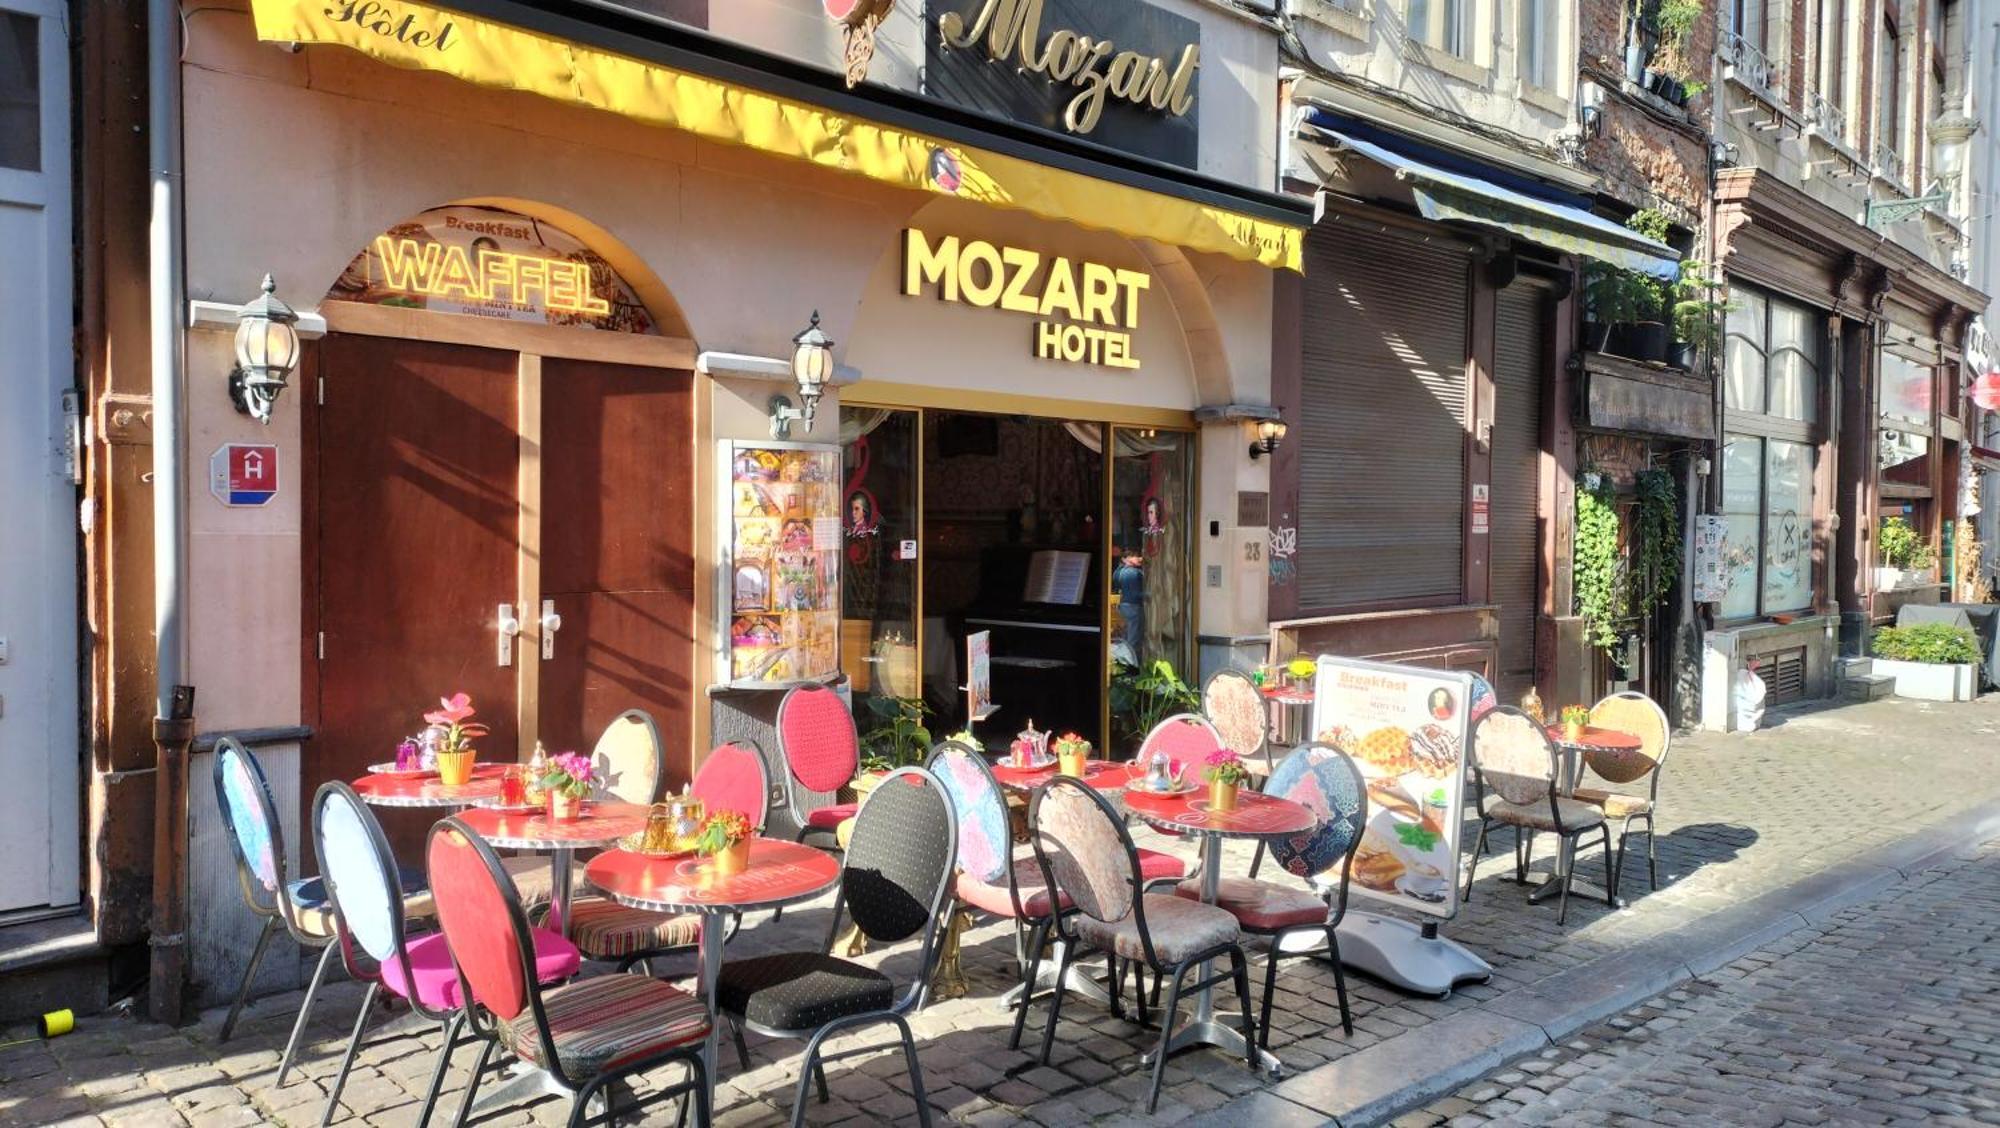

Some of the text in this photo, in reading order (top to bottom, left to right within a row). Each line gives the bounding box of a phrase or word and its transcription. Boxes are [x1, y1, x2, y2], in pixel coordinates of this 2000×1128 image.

[323, 0, 459, 52] Hôtel
[939, 0, 1200, 134] Mozart
[445, 215, 531, 241] Breakfast
[376, 235, 610, 315] WAFFEL
[904, 227, 1151, 329] MOZART
[1037, 320, 1141, 370] HOTEL
[1244, 541, 1261, 562] 23
[1339, 671, 1408, 692] Breakfast
